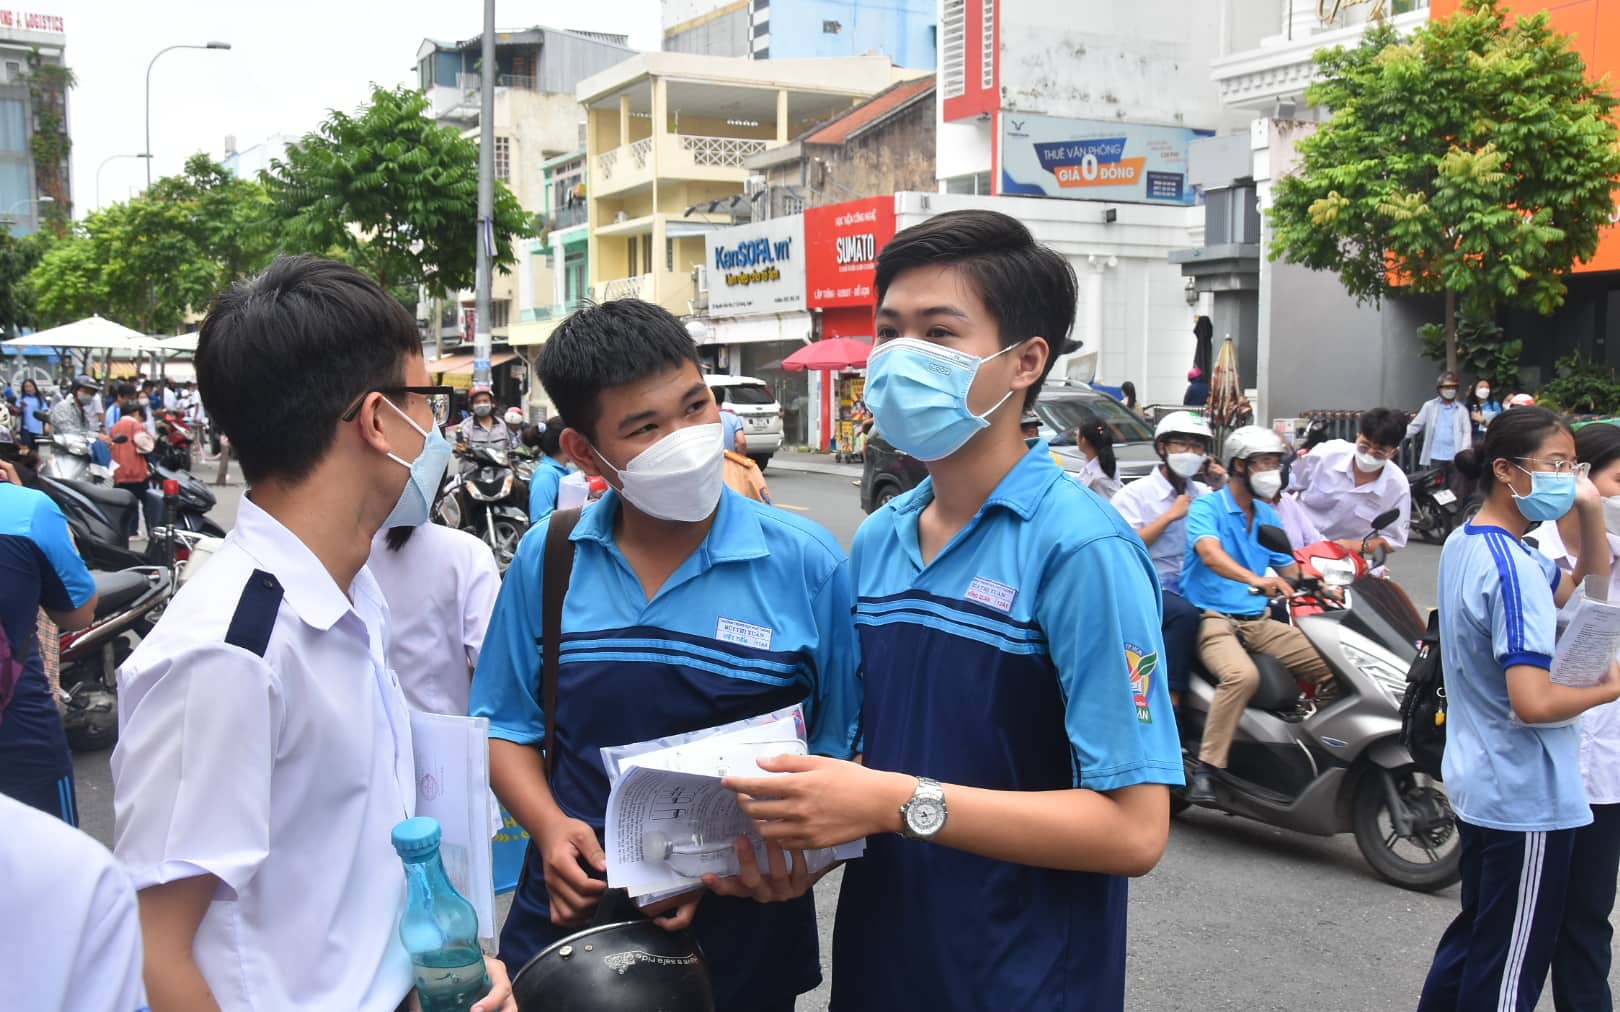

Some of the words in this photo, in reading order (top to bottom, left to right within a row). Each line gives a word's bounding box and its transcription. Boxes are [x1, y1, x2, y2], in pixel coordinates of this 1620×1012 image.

[24, 13, 64, 32] LOGISTICS
[1044, 146, 1065, 160] THUÊ
[1066, 144, 1087, 158] VĂN
[1088, 143, 1121, 156] PHÒNG
[1058, 164, 1081, 182] GIÁ
[1081, 153, 1098, 181] 0
[1100, 162, 1136, 180] ĐỒNG
[715, 237, 790, 270] KenSOFA.vn
